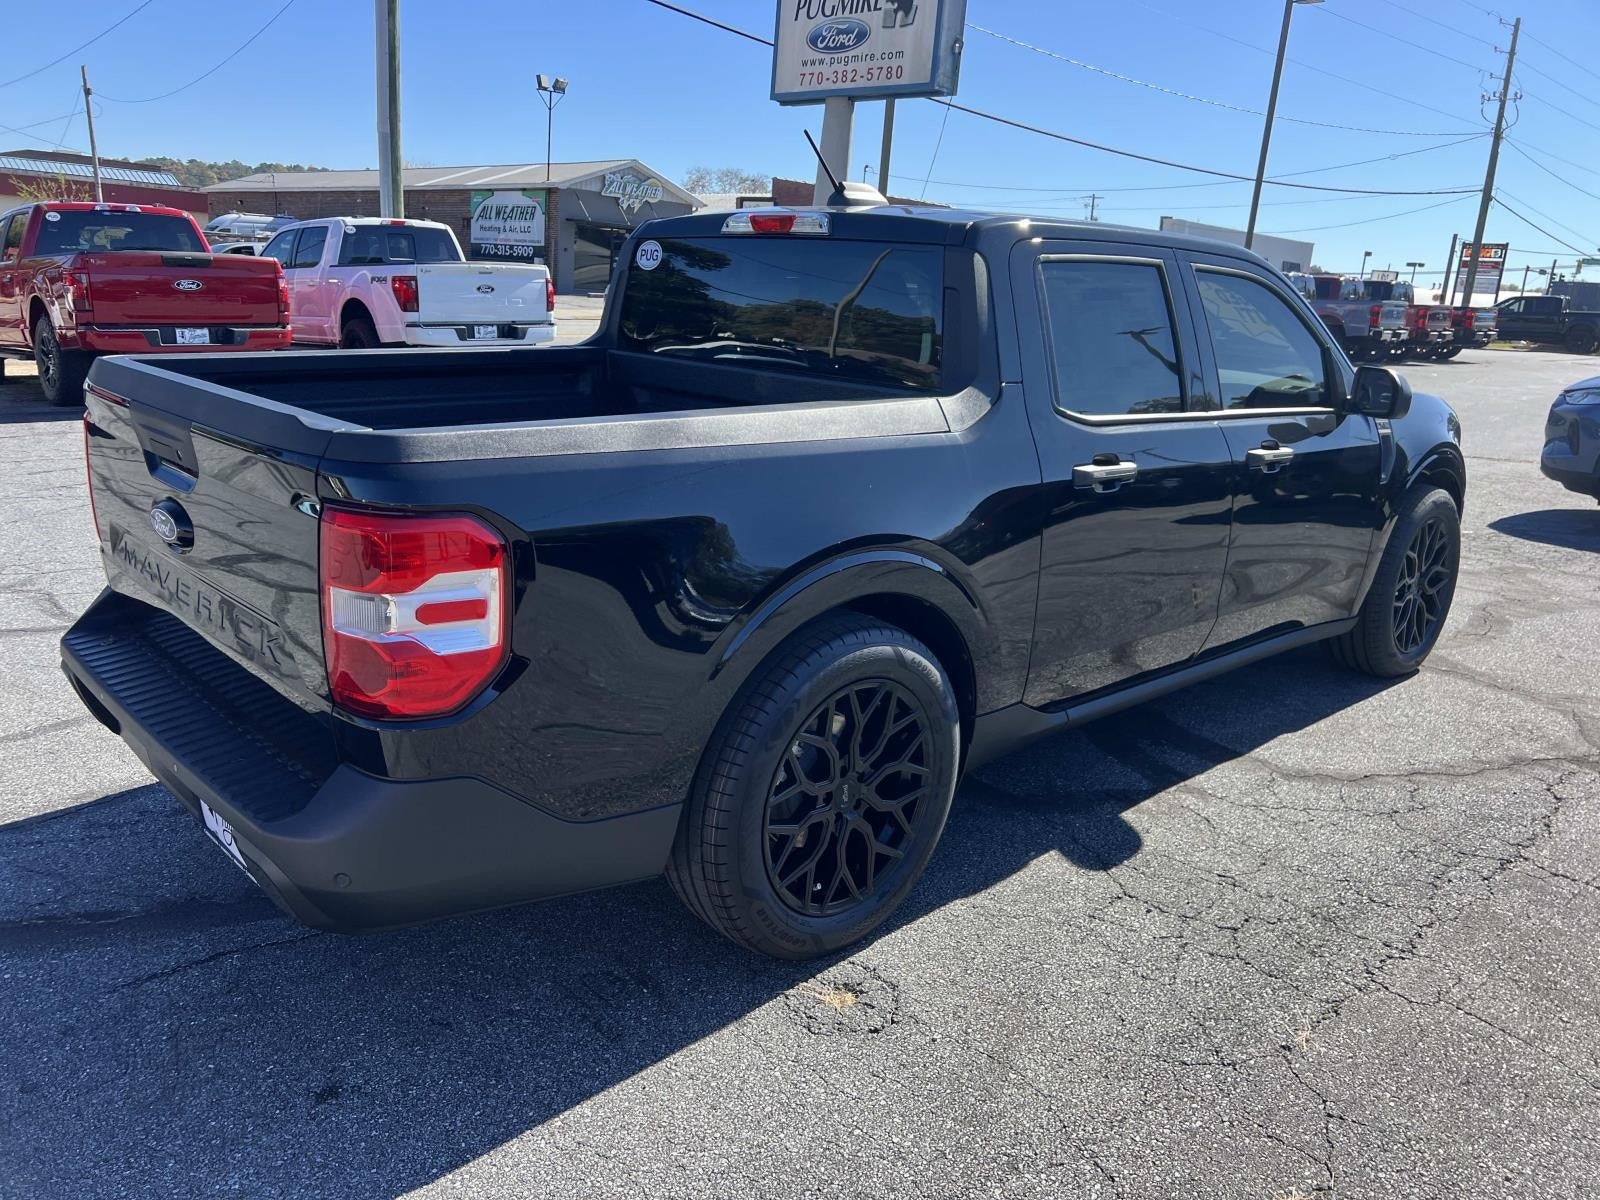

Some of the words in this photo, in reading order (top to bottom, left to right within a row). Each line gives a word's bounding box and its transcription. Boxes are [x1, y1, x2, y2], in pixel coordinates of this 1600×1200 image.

[817, 24, 858, 49] Ford
[801, 49, 904, 68] www.pugmire.com
[799, 65, 903, 86] 770-382-5780
[607, 181, 624, 194] ALL
[625, 182, 661, 198] WEATHER
[476, 205, 494, 222] ALL
[494, 205, 537, 222] WEATHER
[480, 224, 501, 233] Heating
[480, 244, 534, 257] 770-315-5909
[640, 248, 659, 261] PUG
[153, 512, 172, 537] Ford
[118, 540, 281, 666] MAVERICK
